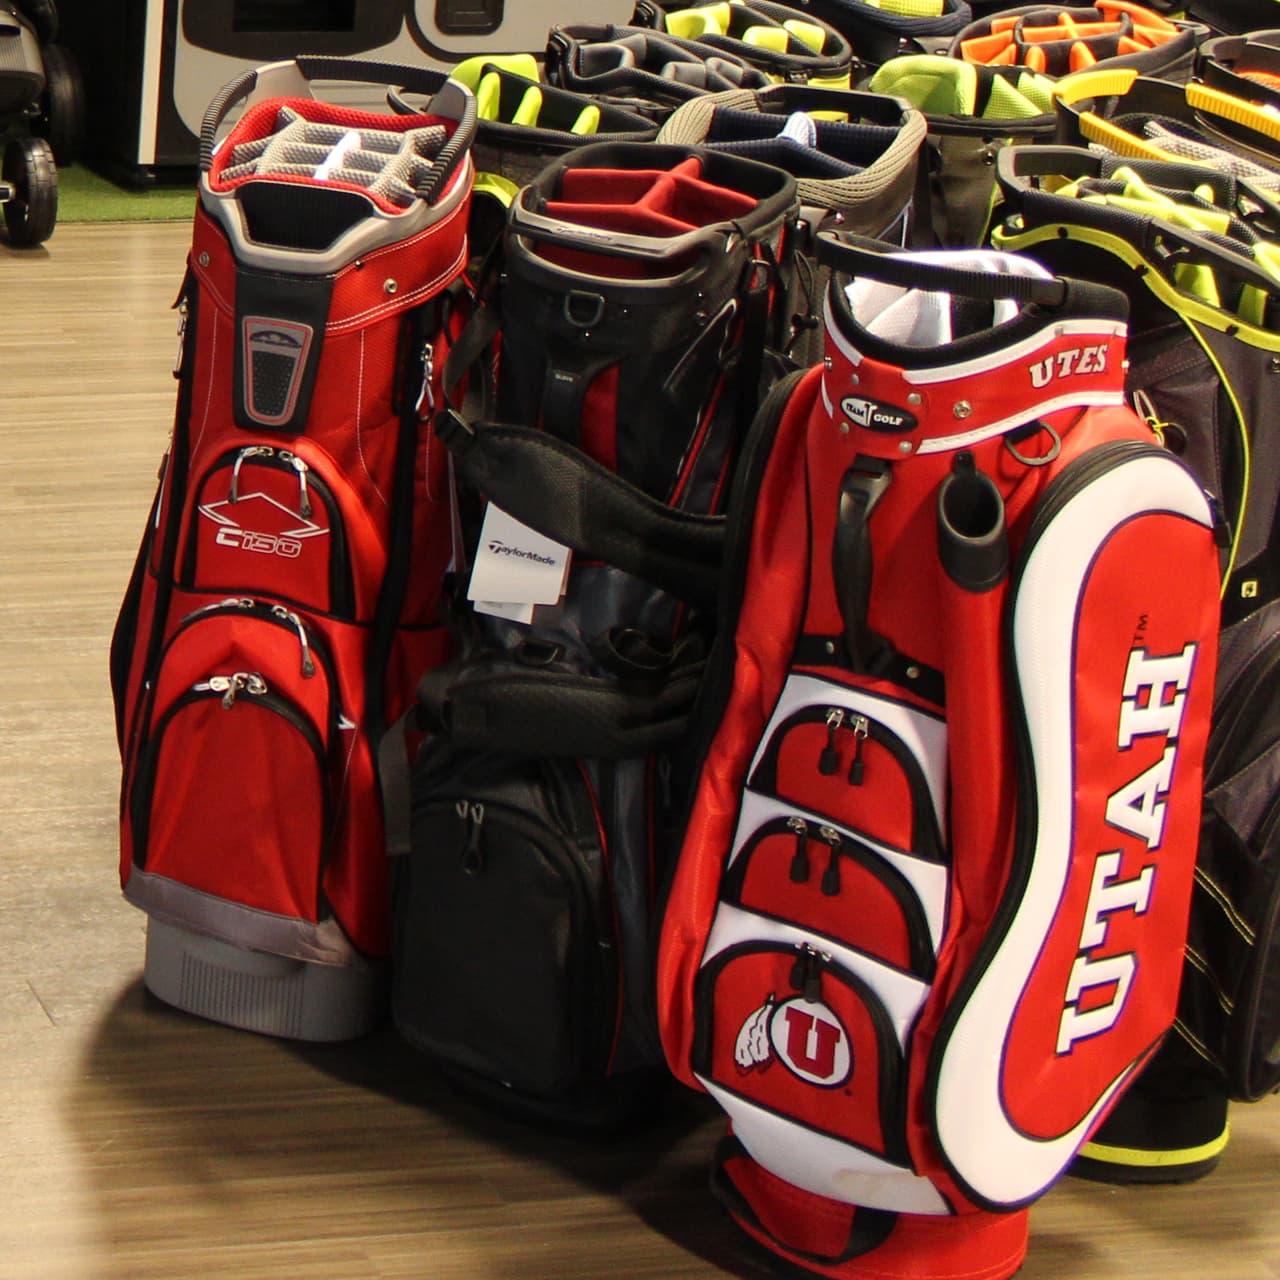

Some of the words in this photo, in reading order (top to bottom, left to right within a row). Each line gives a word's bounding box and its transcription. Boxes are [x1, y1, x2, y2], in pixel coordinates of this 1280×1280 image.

[1029, 343, 1109, 390] UTES
[846, 402, 864, 417] TEAM
[873, 413, 903, 426] GOLF
[488, 540, 556, 565] TaylorMade
[1056, 640, 1199, 1056] UTAH
[785, 1006, 841, 1079] U
